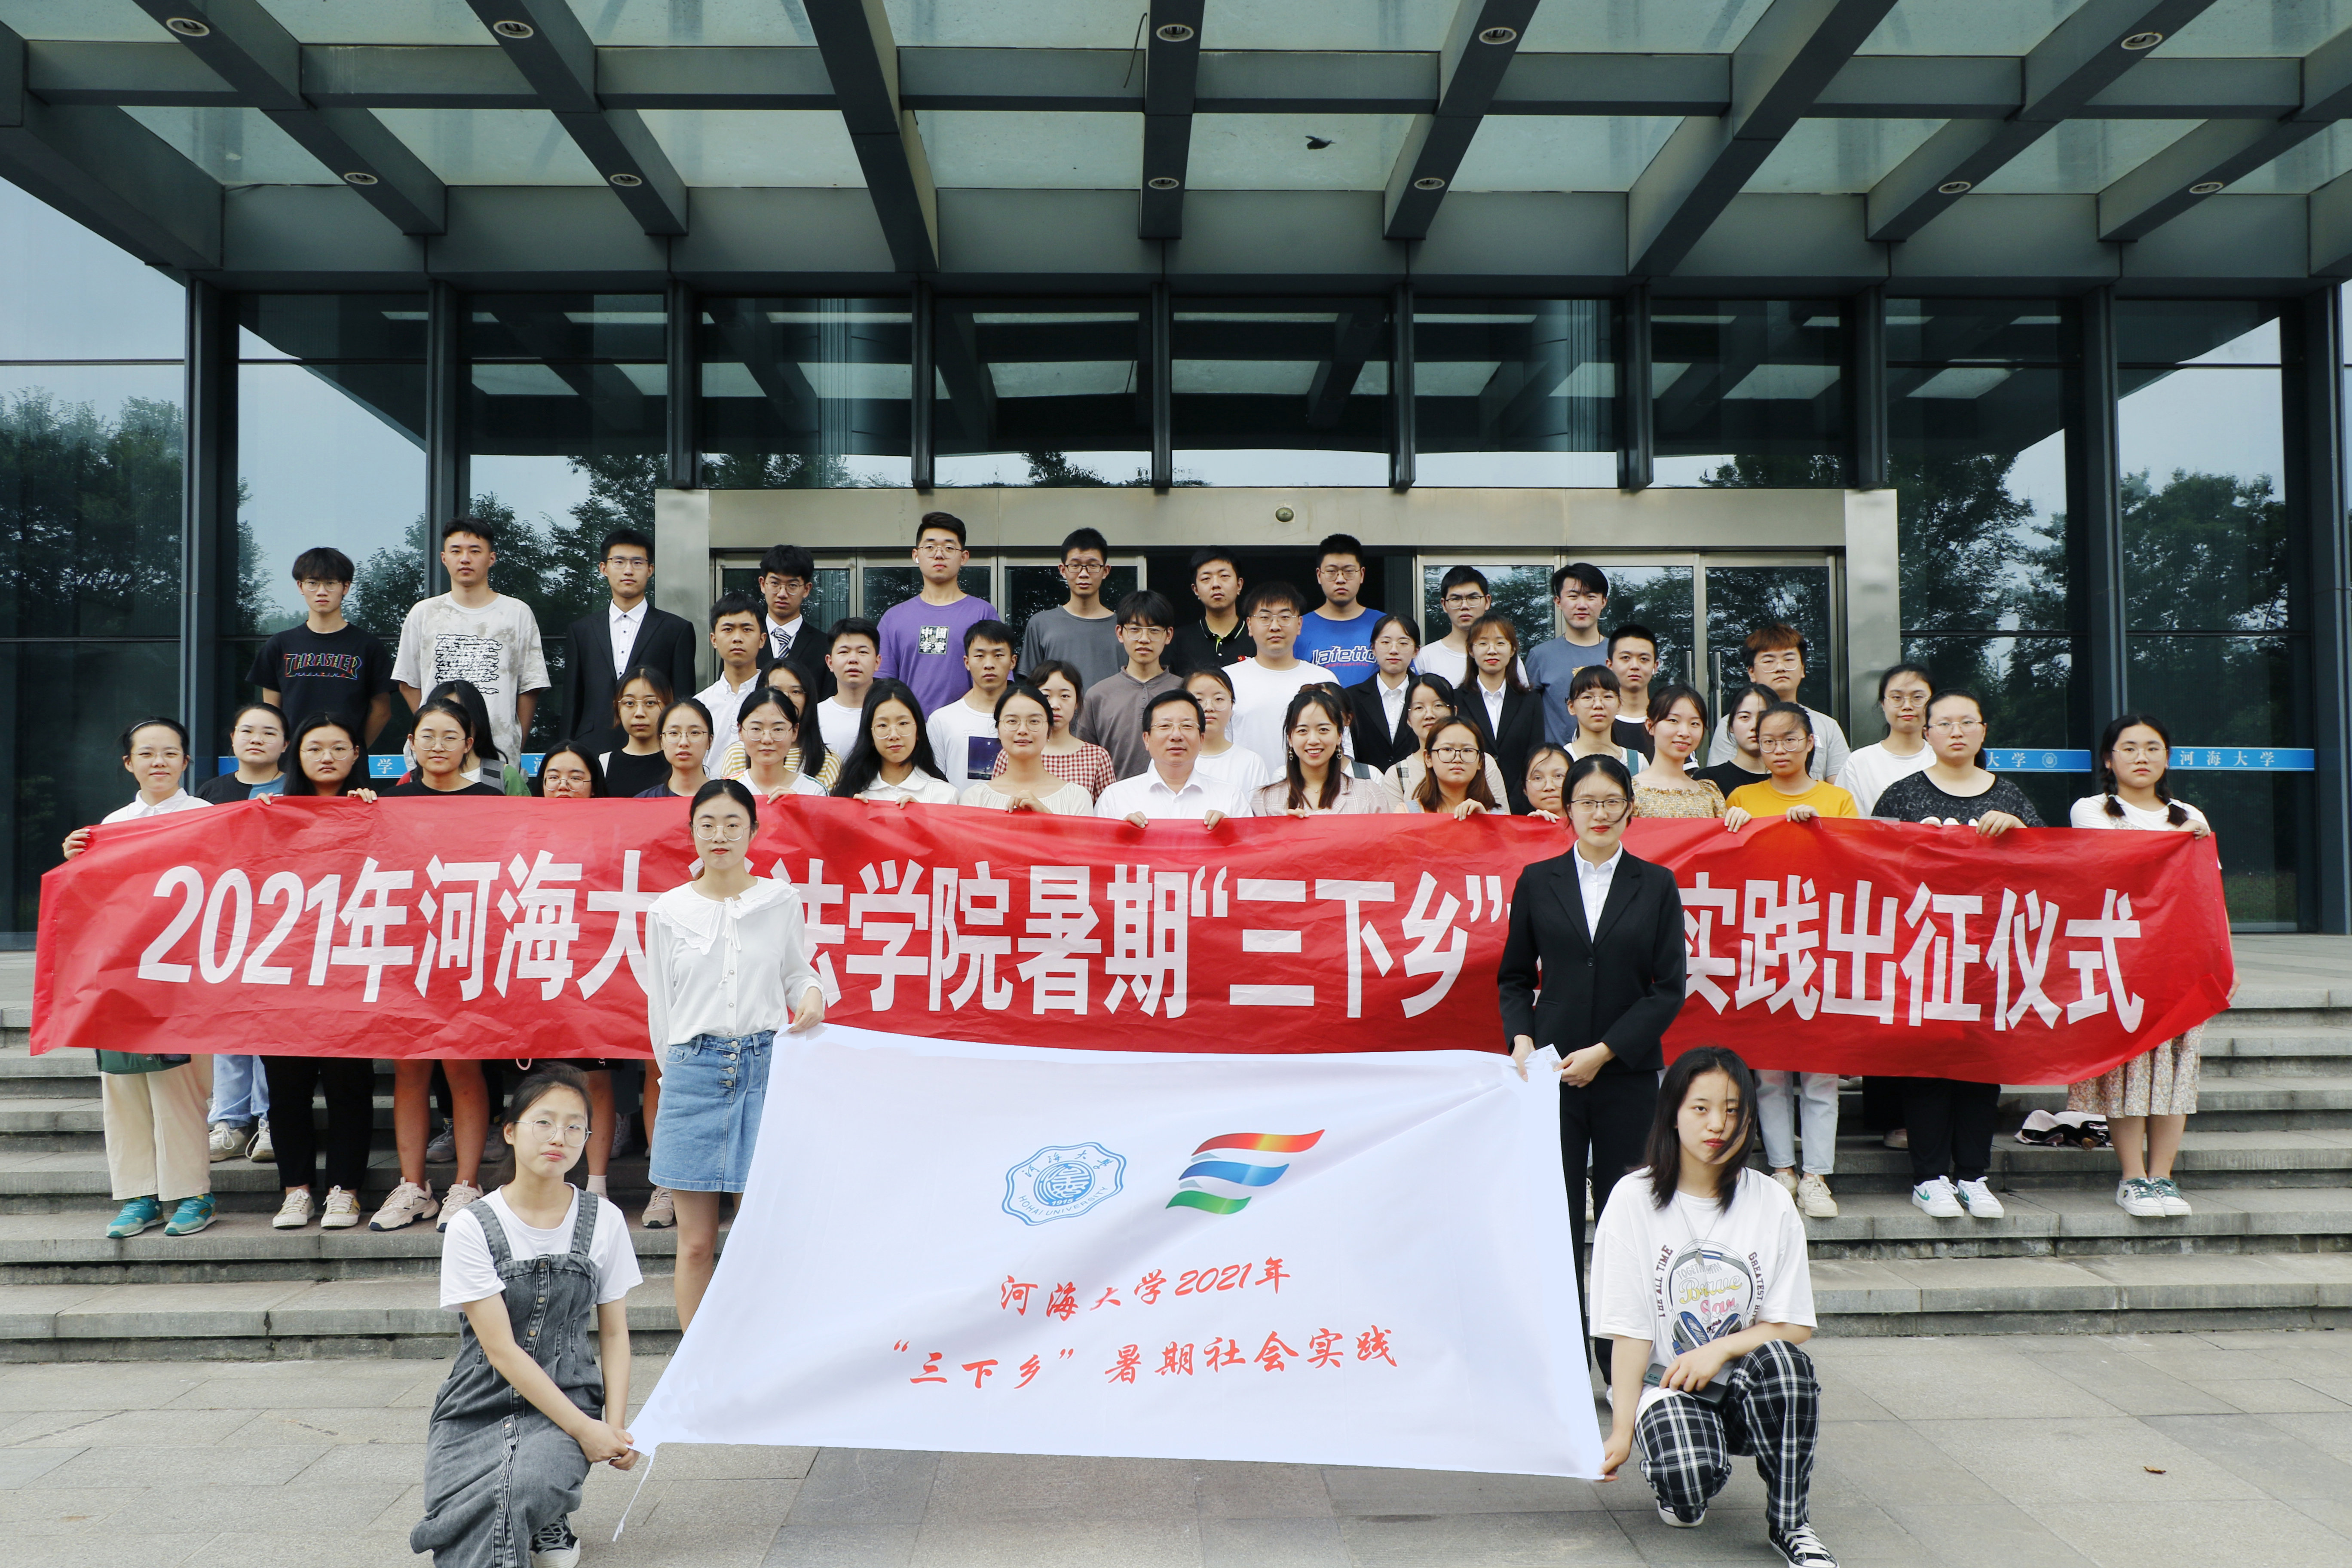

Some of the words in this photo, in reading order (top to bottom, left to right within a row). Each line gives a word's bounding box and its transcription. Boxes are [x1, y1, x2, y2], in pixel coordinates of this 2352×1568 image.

[284, 652, 362, 680] THRASHER
[377, 758, 393, 774] 学
[1986, 752, 2027, 768] 大学
[2180, 750, 2275, 767] 河海大学
[138, 849, 2144, 1034] 2021年河海大法学院暑期“三下乡”实践出征仪式
[1018, 1194, 1044, 1216] HOHAI
[1045, 1186, 1109, 1216] UNIVERSITY
[1656, 1245, 1673, 1272] TIME
[1001, 1256, 1290, 1321] 河海大学2021年
[1748, 1251, 1764, 1301] GREATEST
